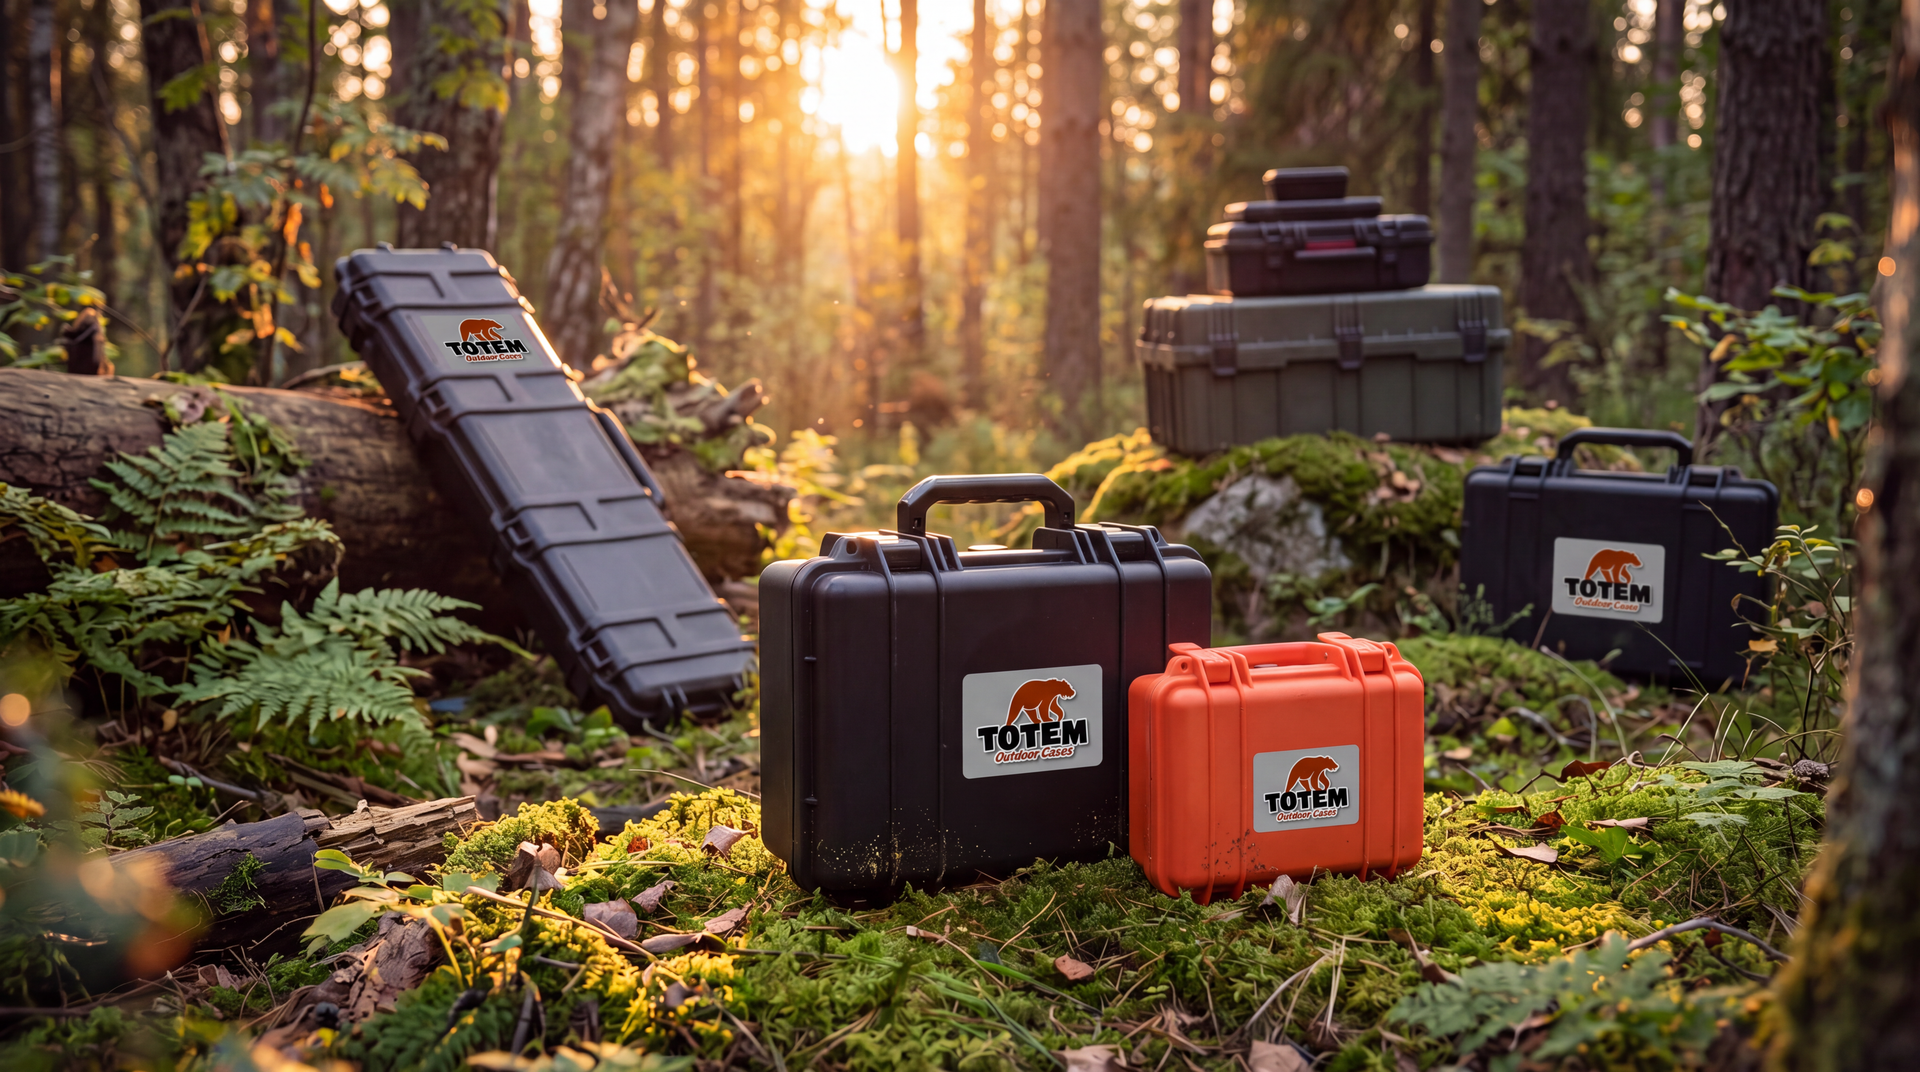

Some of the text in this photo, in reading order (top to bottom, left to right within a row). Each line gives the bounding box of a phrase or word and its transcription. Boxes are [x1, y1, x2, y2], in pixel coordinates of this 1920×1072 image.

[445, 340, 528, 355] TOTEM
[1564, 578, 1650, 604] TOTEM
[978, 719, 1088, 751] TOTEM
[995, 747, 1074, 763] Outdoor Cases
[1264, 788, 1348, 813] TOTEM
[1277, 809, 1337, 821] Outdoor Cases
